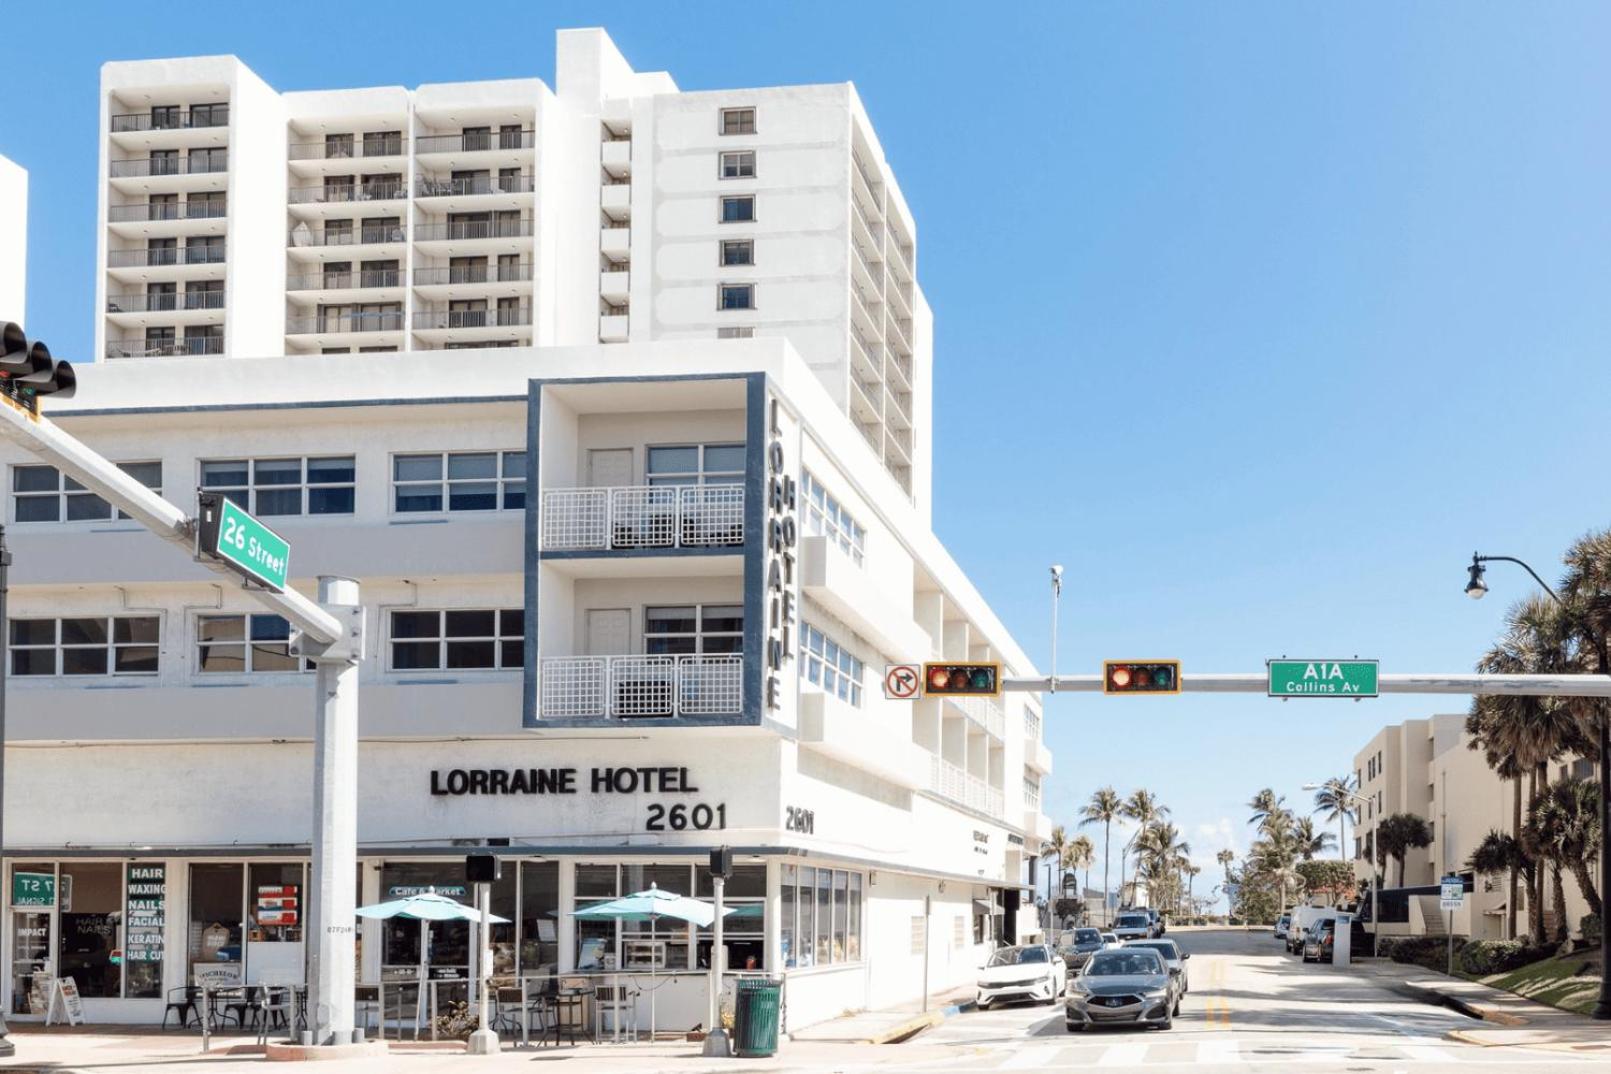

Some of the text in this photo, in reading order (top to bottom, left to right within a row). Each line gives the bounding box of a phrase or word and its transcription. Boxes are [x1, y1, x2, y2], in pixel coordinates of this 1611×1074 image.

[223, 516, 285, 576] 26 Street
[767, 398, 784, 711] LORRAINE
[782, 474, 796, 661] HOTEL
[1303, 663, 1344, 680] A1A
[1286, 681, 1360, 693] Collins Av
[430, 767, 699, 795] LORRAINE HOTEL
[646, 803, 726, 831] 2601
[785, 806, 815, 835] 2601
[131, 868, 164, 879] HAIR
[128, 884, 167, 894] WAXING
[427, 887, 461, 896] arket
[128, 900, 165, 910] NAILS
[17, 928, 47, 937] IMPACT
[128, 934, 166, 944] KERATIN
[127, 950, 147, 960] HAIR
